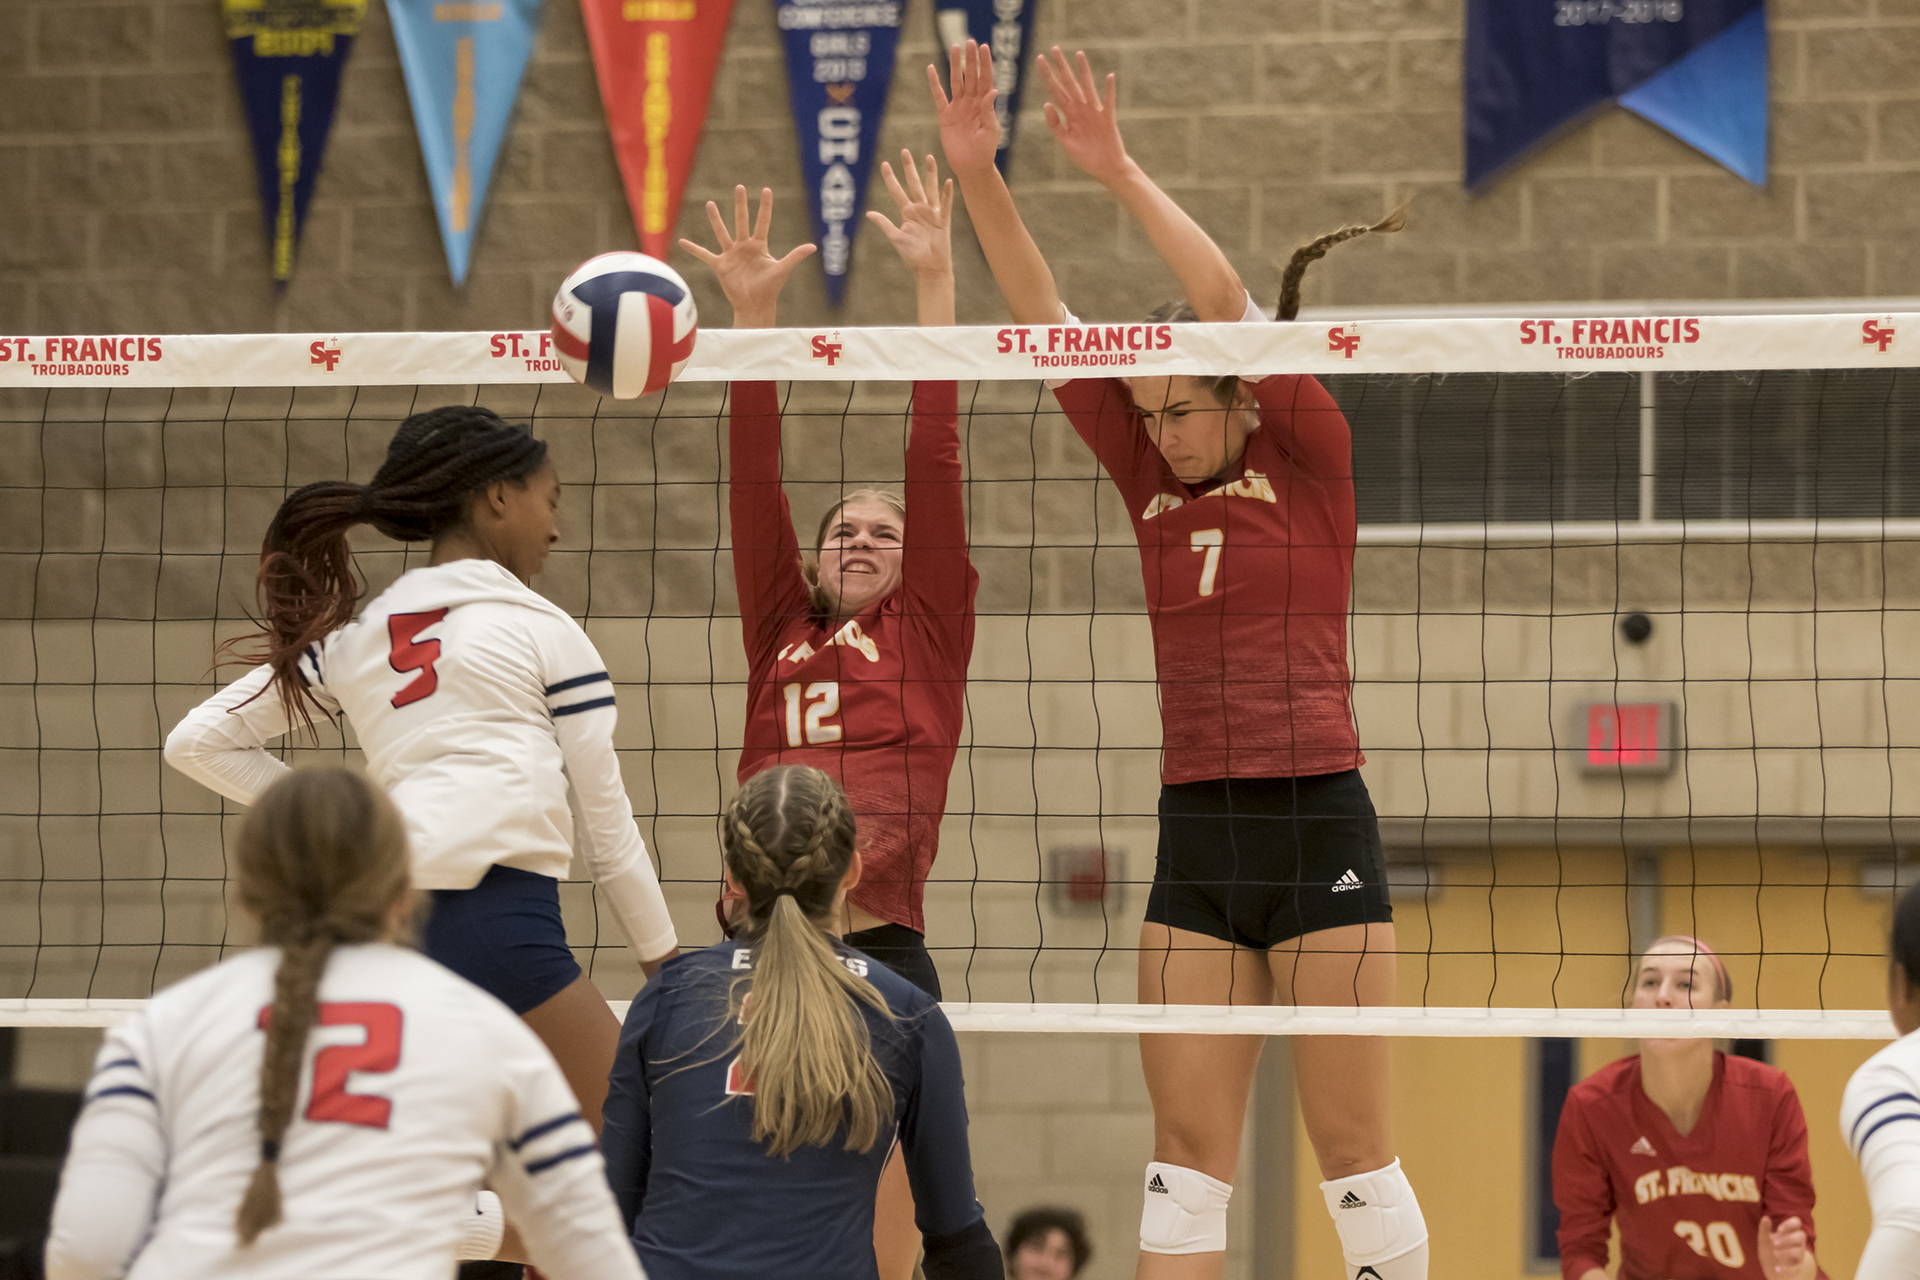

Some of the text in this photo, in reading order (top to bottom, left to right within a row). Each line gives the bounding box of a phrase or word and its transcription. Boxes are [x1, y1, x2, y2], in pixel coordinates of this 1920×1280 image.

[996, 325, 1173, 354] ST. FRANCIS
[1520, 318, 1700, 344] ST. FRANCIS
[0, 337, 163, 362] ST. FRANCIS
[490, 333, 531, 358] ST.
[1556, 346, 1664, 359] TROUBADOURS
[31, 363, 130, 376] TROUBADOURS
[1032, 353, 1137, 367] TROUBADOURS
[1190, 528, 1224, 597] 7
[388, 606, 449, 709] 5
[783, 681, 842, 747] 12
[1148, 1185, 1169, 1194] adidas
[1339, 1200, 1367, 1209] adidas
